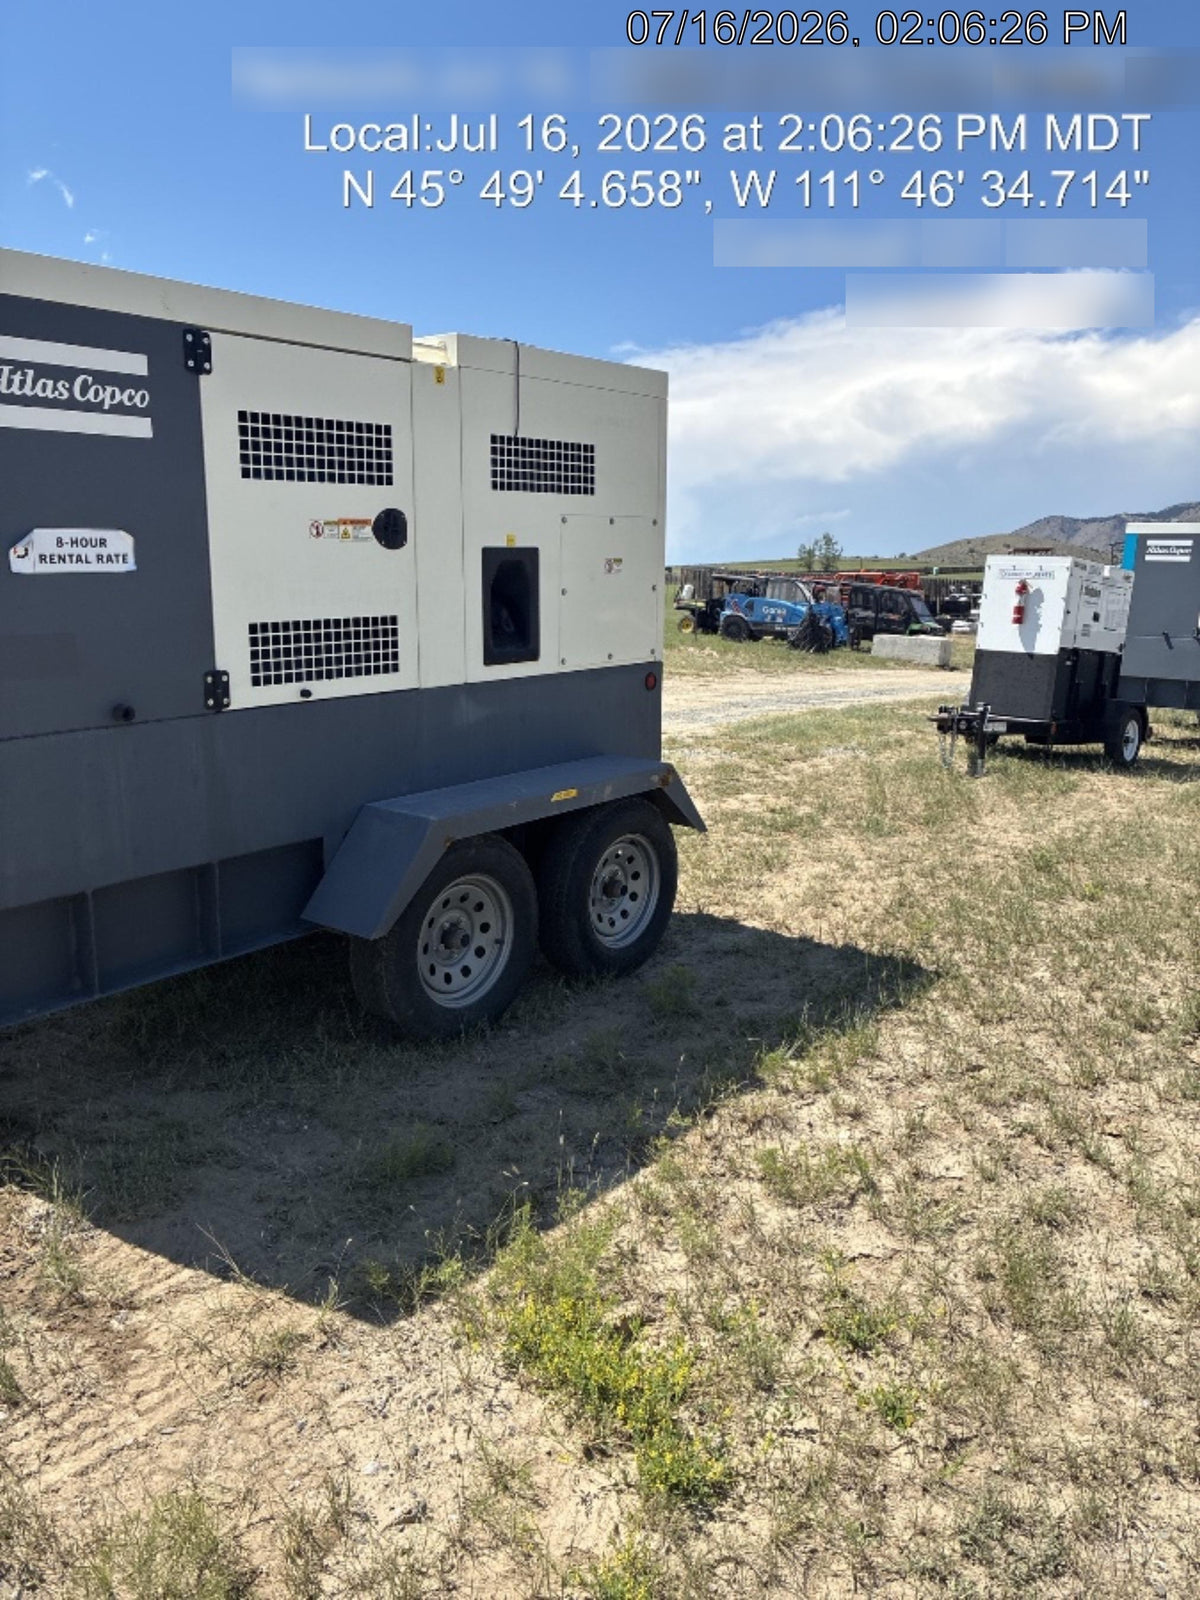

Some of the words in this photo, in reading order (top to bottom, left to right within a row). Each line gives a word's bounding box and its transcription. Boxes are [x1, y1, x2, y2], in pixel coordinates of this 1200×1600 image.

[74, 374, 150, 410] Copco
[56, 536, 107, 549] 8-HOUR
[38, 553, 92, 565] RENTAL
[96, 553, 129, 565] RATE
